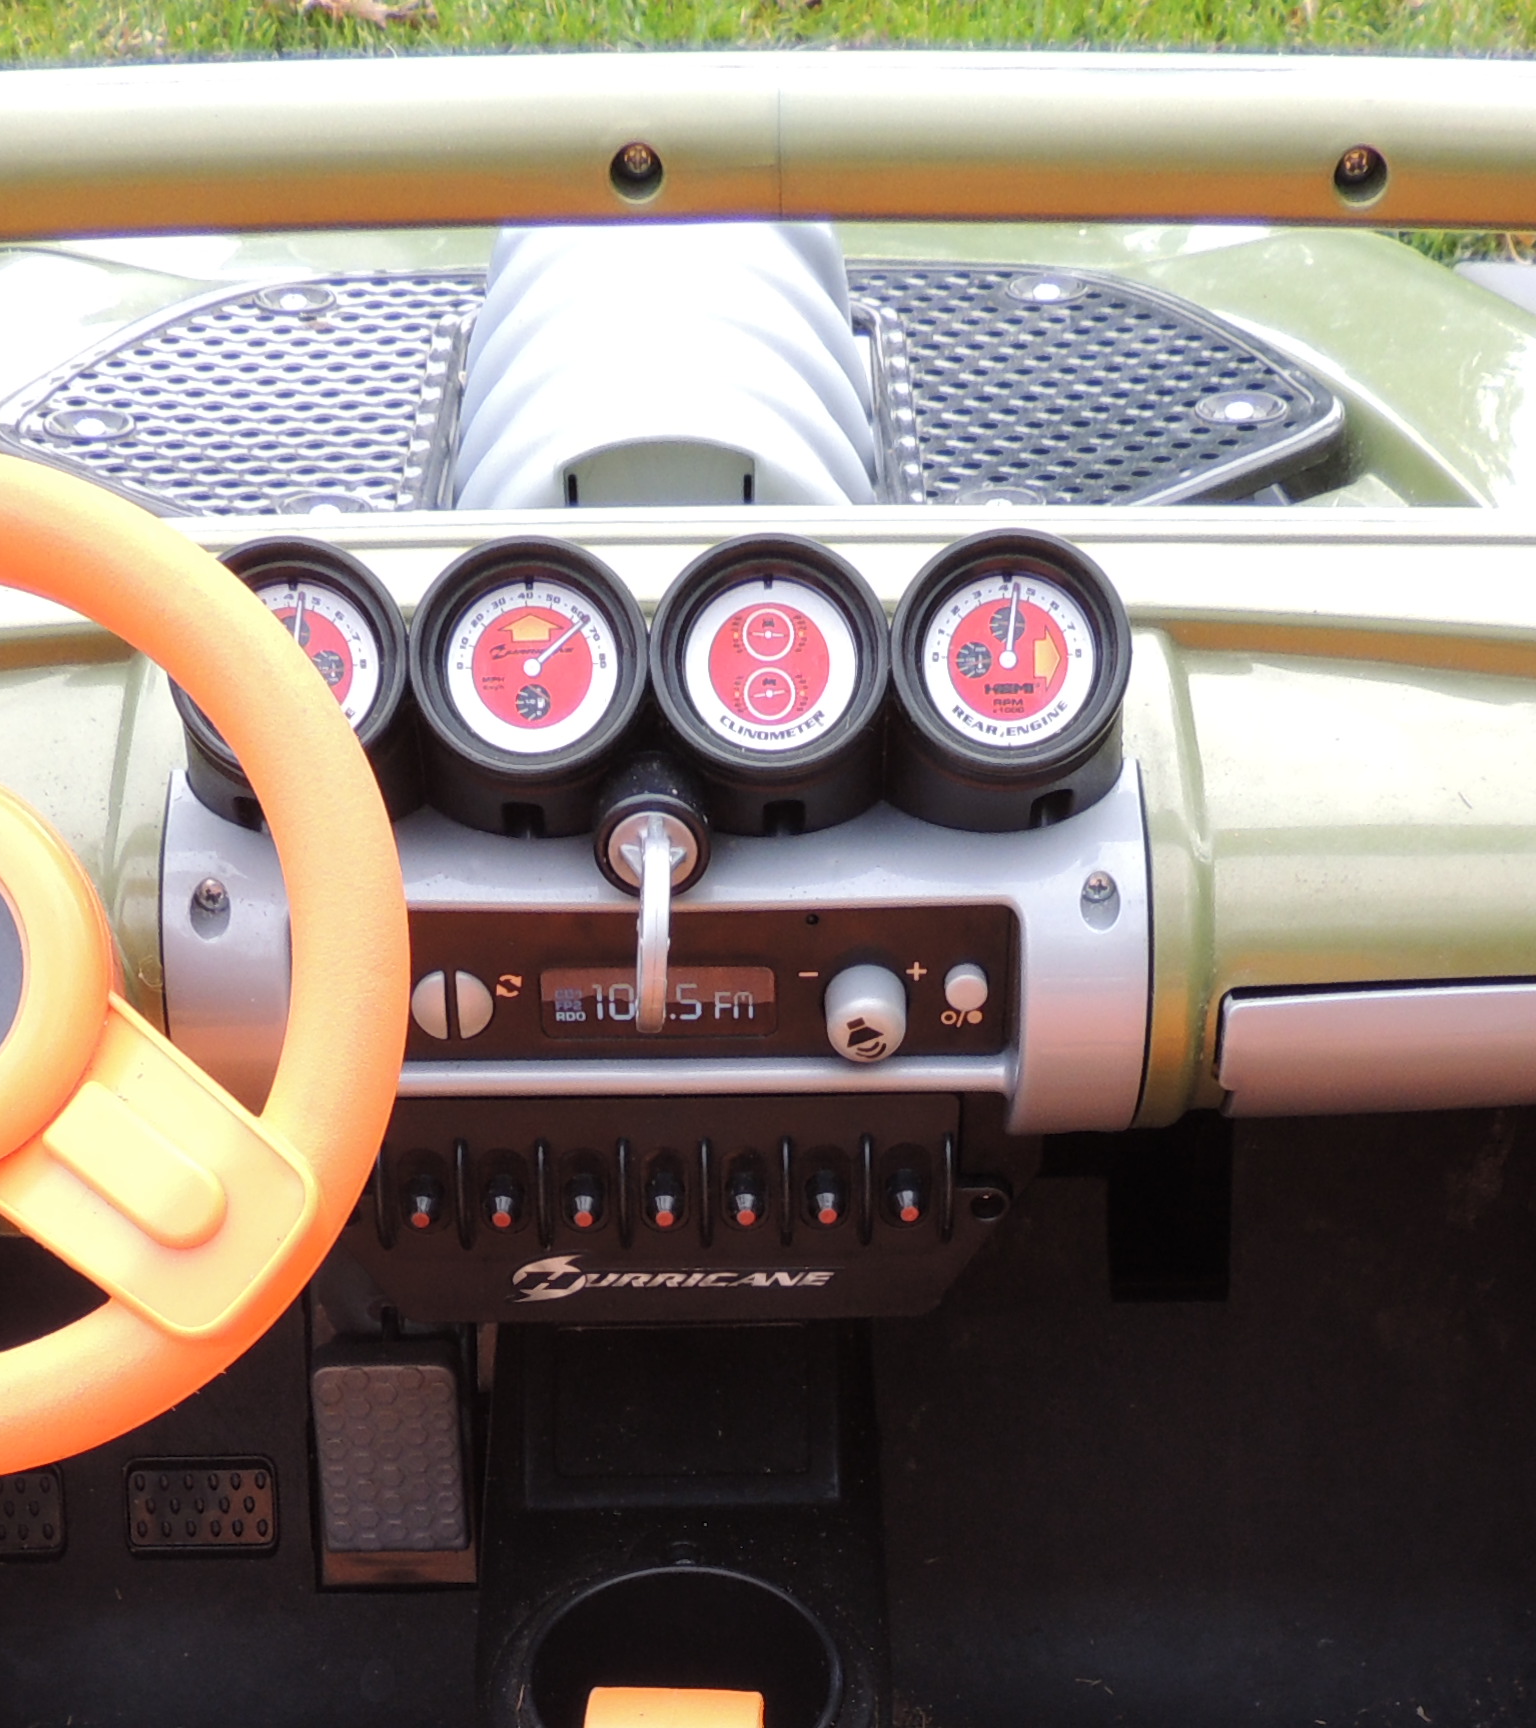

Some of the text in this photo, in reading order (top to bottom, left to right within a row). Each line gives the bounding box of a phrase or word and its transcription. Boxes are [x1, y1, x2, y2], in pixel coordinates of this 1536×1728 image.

[470, 613, 484, 628] 20
[491, 597, 506, 609] 30
[546, 593, 561, 604] 50
[589, 627, 600, 641] 70
[951, 700, 1068, 737] REAR ENGINE
[993, 698, 1024, 706] RPM
[719, 710, 825, 741] CLINOMETER
[555, 1011, 586, 1022] RDO
[592, 983, 754, 1021] 10.5 FM
